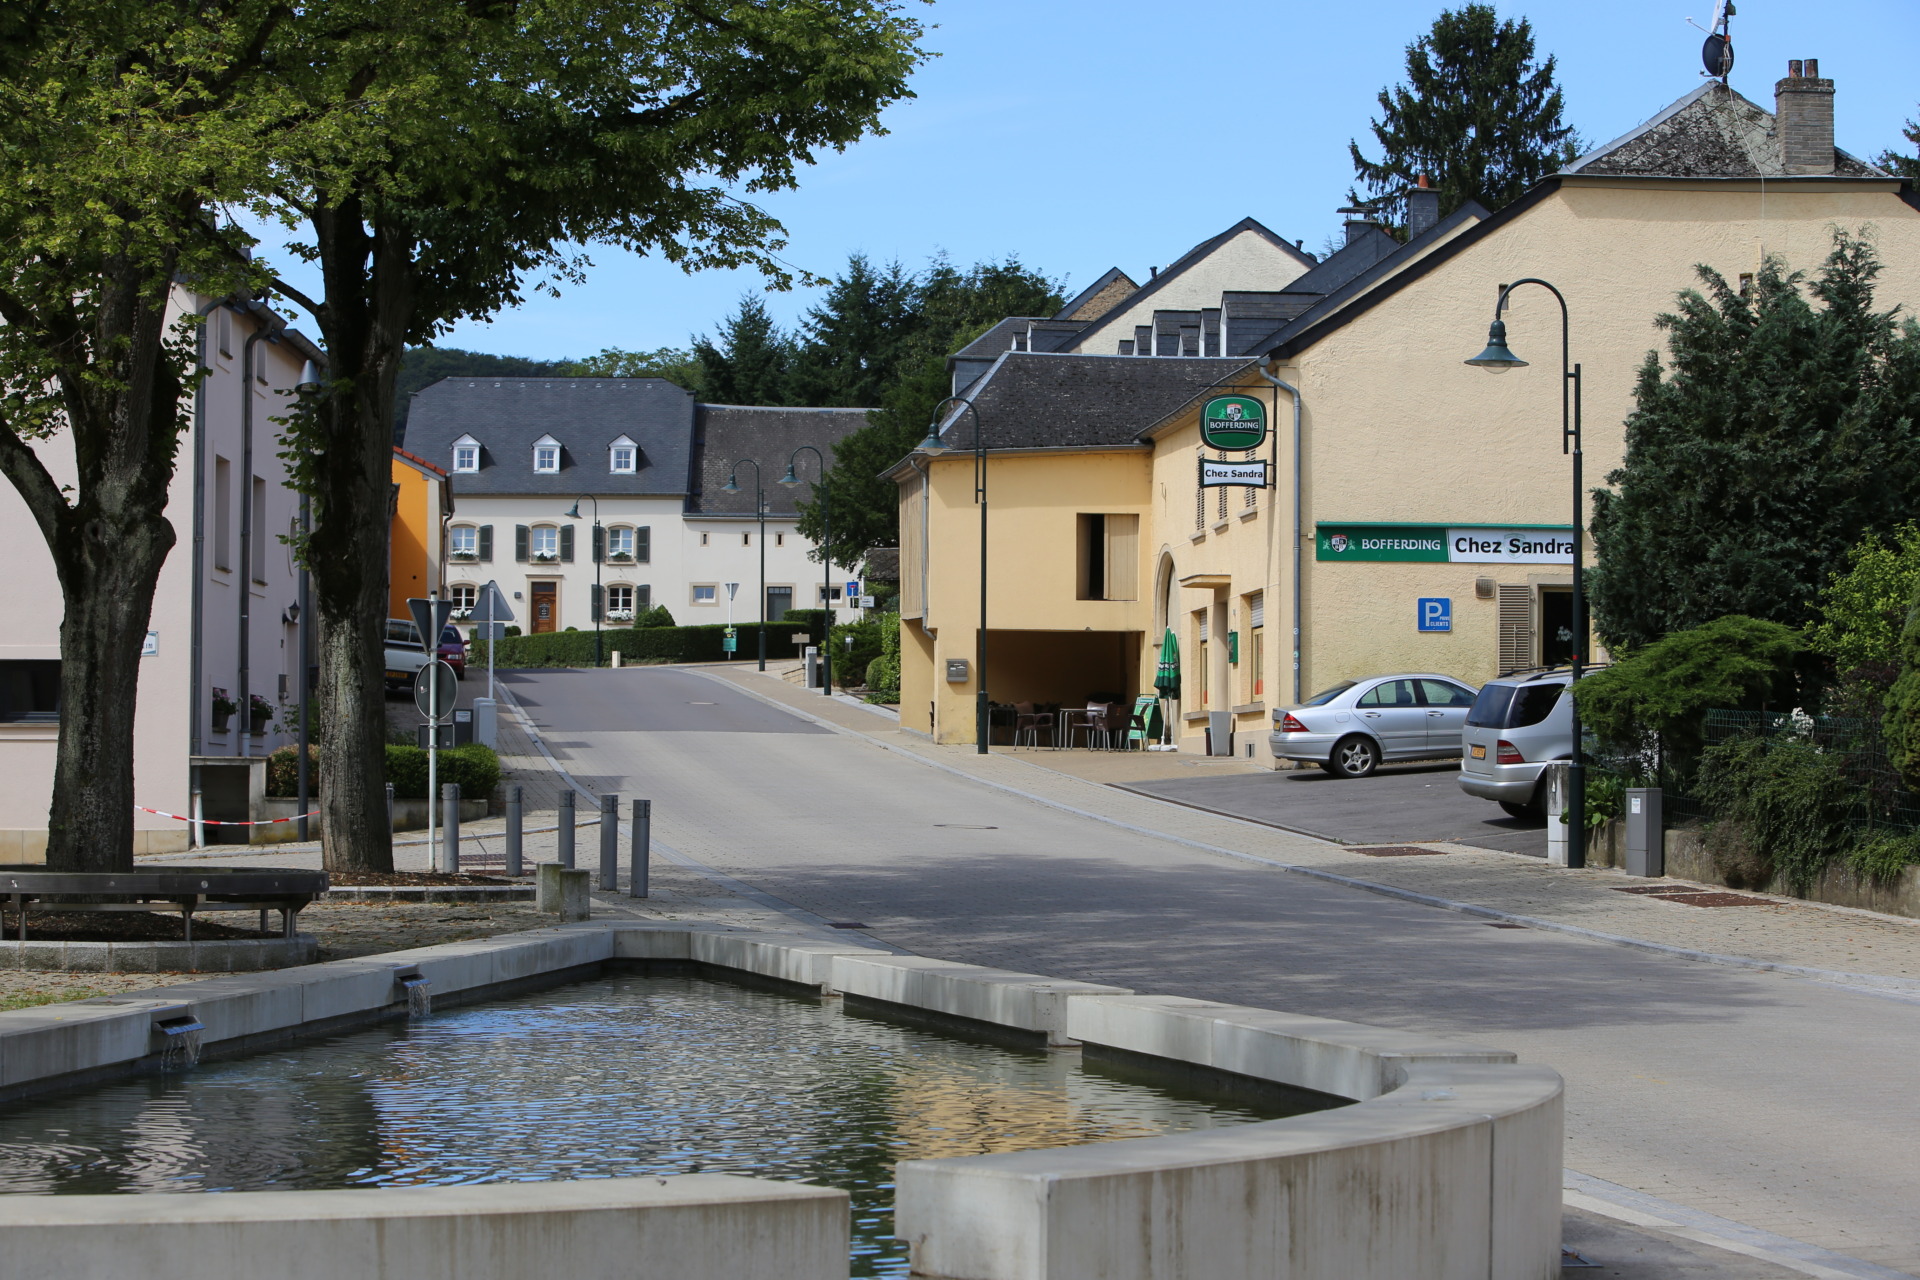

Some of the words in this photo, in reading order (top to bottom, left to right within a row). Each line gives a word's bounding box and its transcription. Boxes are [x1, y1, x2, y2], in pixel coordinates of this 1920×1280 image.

[1210, 421, 1259, 429] BOFFERDING
[1205, 469, 1228, 478] Chez
[1231, 469, 1263, 478] Sandra
[1361, 538, 1441, 551] BOFFERDING
[1455, 537, 1502, 553] Chez
[1509, 538, 1574, 554] Sandra
[1425, 602, 1443, 626] P
